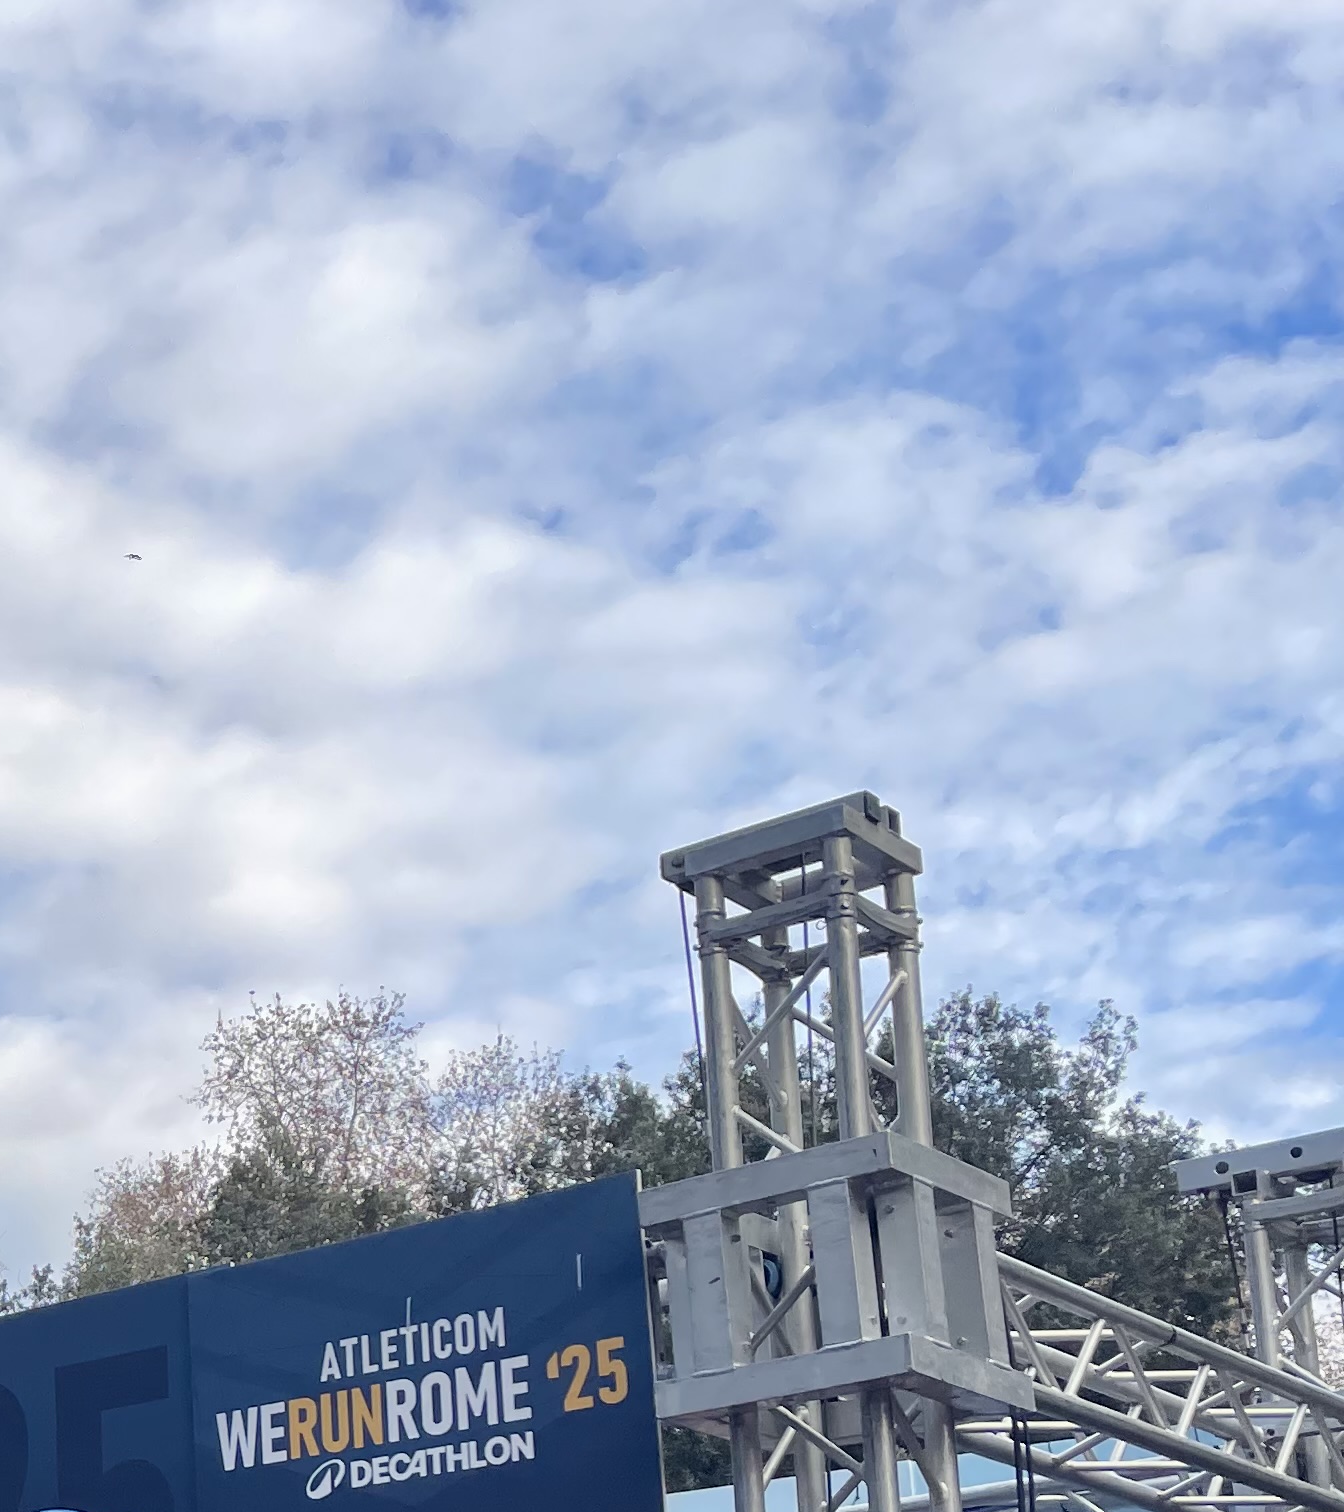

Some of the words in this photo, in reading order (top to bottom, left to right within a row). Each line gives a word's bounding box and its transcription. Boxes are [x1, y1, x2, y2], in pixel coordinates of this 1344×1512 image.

[320, 1307, 505, 1383] ATLETICOM
[216, 1355, 532, 1472] WERUNROME
[545, 1336, 629, 1413] '25
[350, 1431, 535, 1490] DECATHLON
